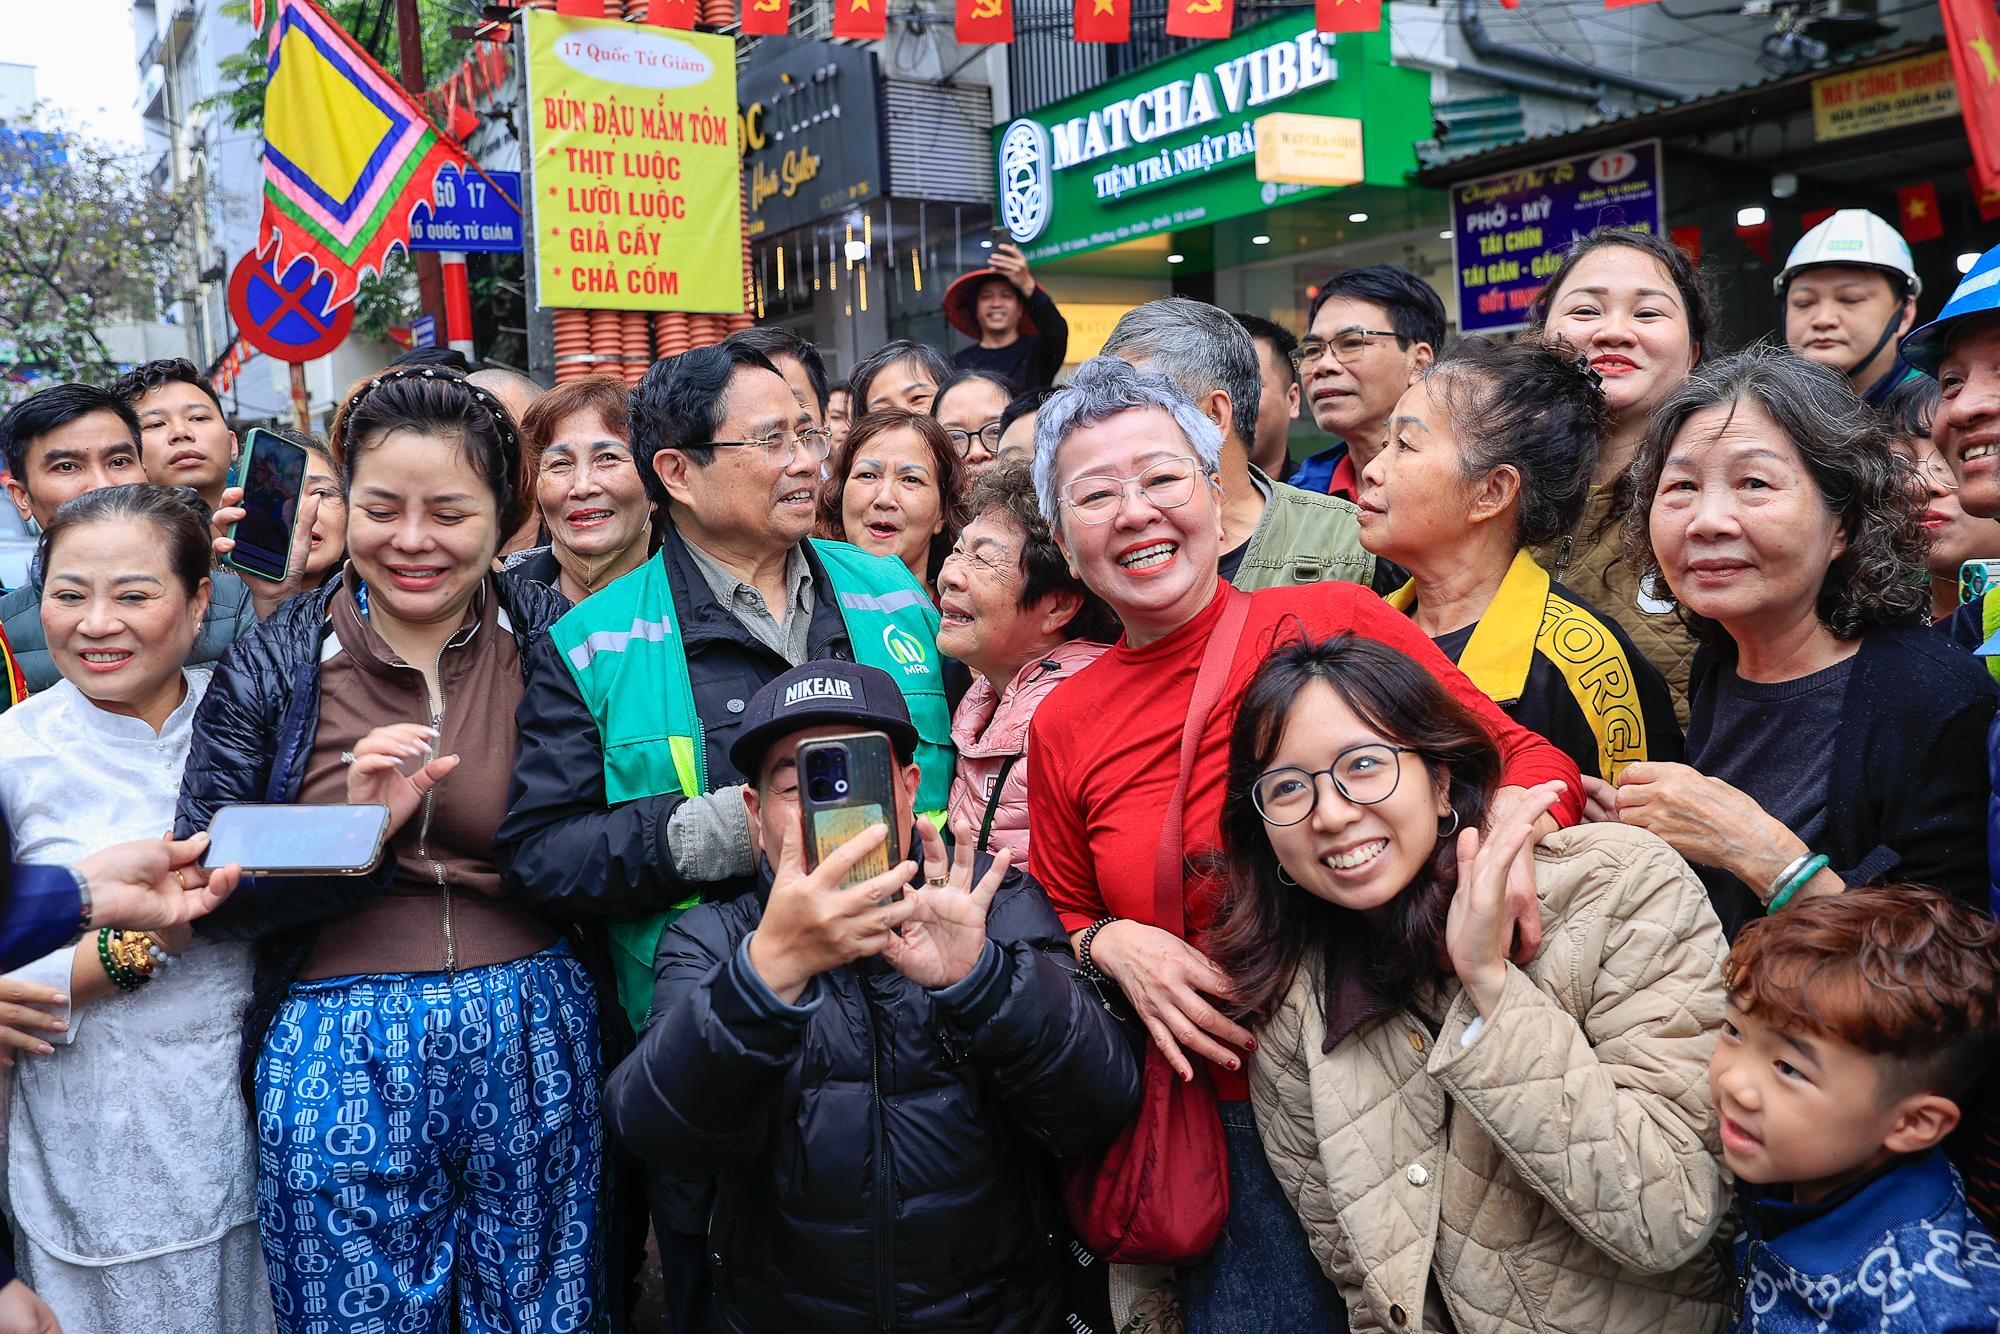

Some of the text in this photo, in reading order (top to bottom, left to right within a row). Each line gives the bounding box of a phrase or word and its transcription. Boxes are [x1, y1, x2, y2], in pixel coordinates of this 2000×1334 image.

[564, 42, 705, 72] 17 Quốc Tử Giám
[1050, 29, 1337, 171] MATCHA VIBE
[544, 90, 727, 146] BÚN ĐẬU MẮM TÔM
[565, 147, 680, 185] THỊT LUỘC
[1093, 121, 1257, 198] TIỆM TRÀ NHẬT BẢ
[1602, 156, 1625, 178] 17
[434, 176, 486, 208] GÕ 17
[568, 184, 685, 224] LƯỠI LUỘC
[427, 219, 461, 241] QUỐC
[463, 219, 480, 240] TỬ
[481, 222, 514, 241] GIÁM
[1467, 203, 1508, 233] PHỞ
[570, 221, 609, 254] GIẢ
[1479, 231, 1503, 257] TÁI
[1505, 226, 1543, 251] CHÍN
[572, 260, 678, 295] CHẢ CỐM
[1462, 264, 1486, 288] TÁI
[903, 664, 930, 675] MRB
